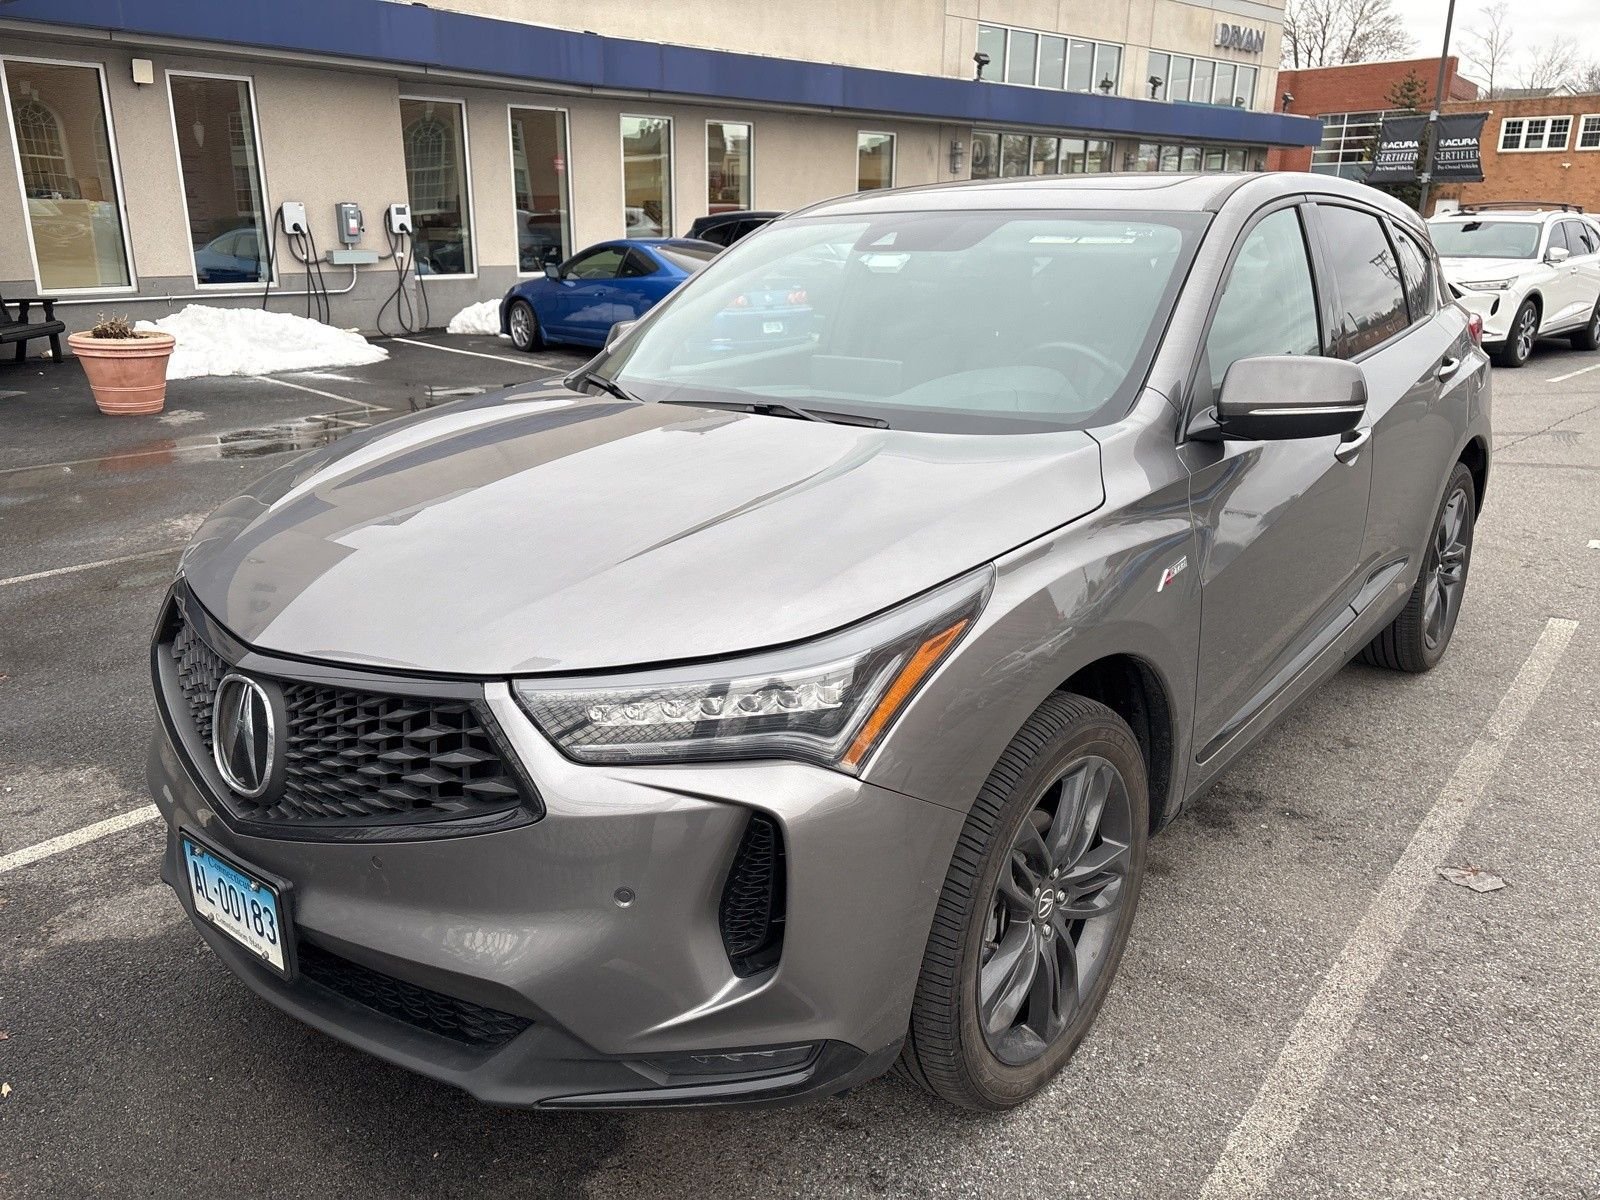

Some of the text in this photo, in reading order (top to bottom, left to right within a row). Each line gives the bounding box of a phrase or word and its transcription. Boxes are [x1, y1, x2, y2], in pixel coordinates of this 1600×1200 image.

[1387, 140, 1419, 149] ACURA
[1445, 137, 1478, 147] ACURA
[207, 856, 252, 891] Connecticut
